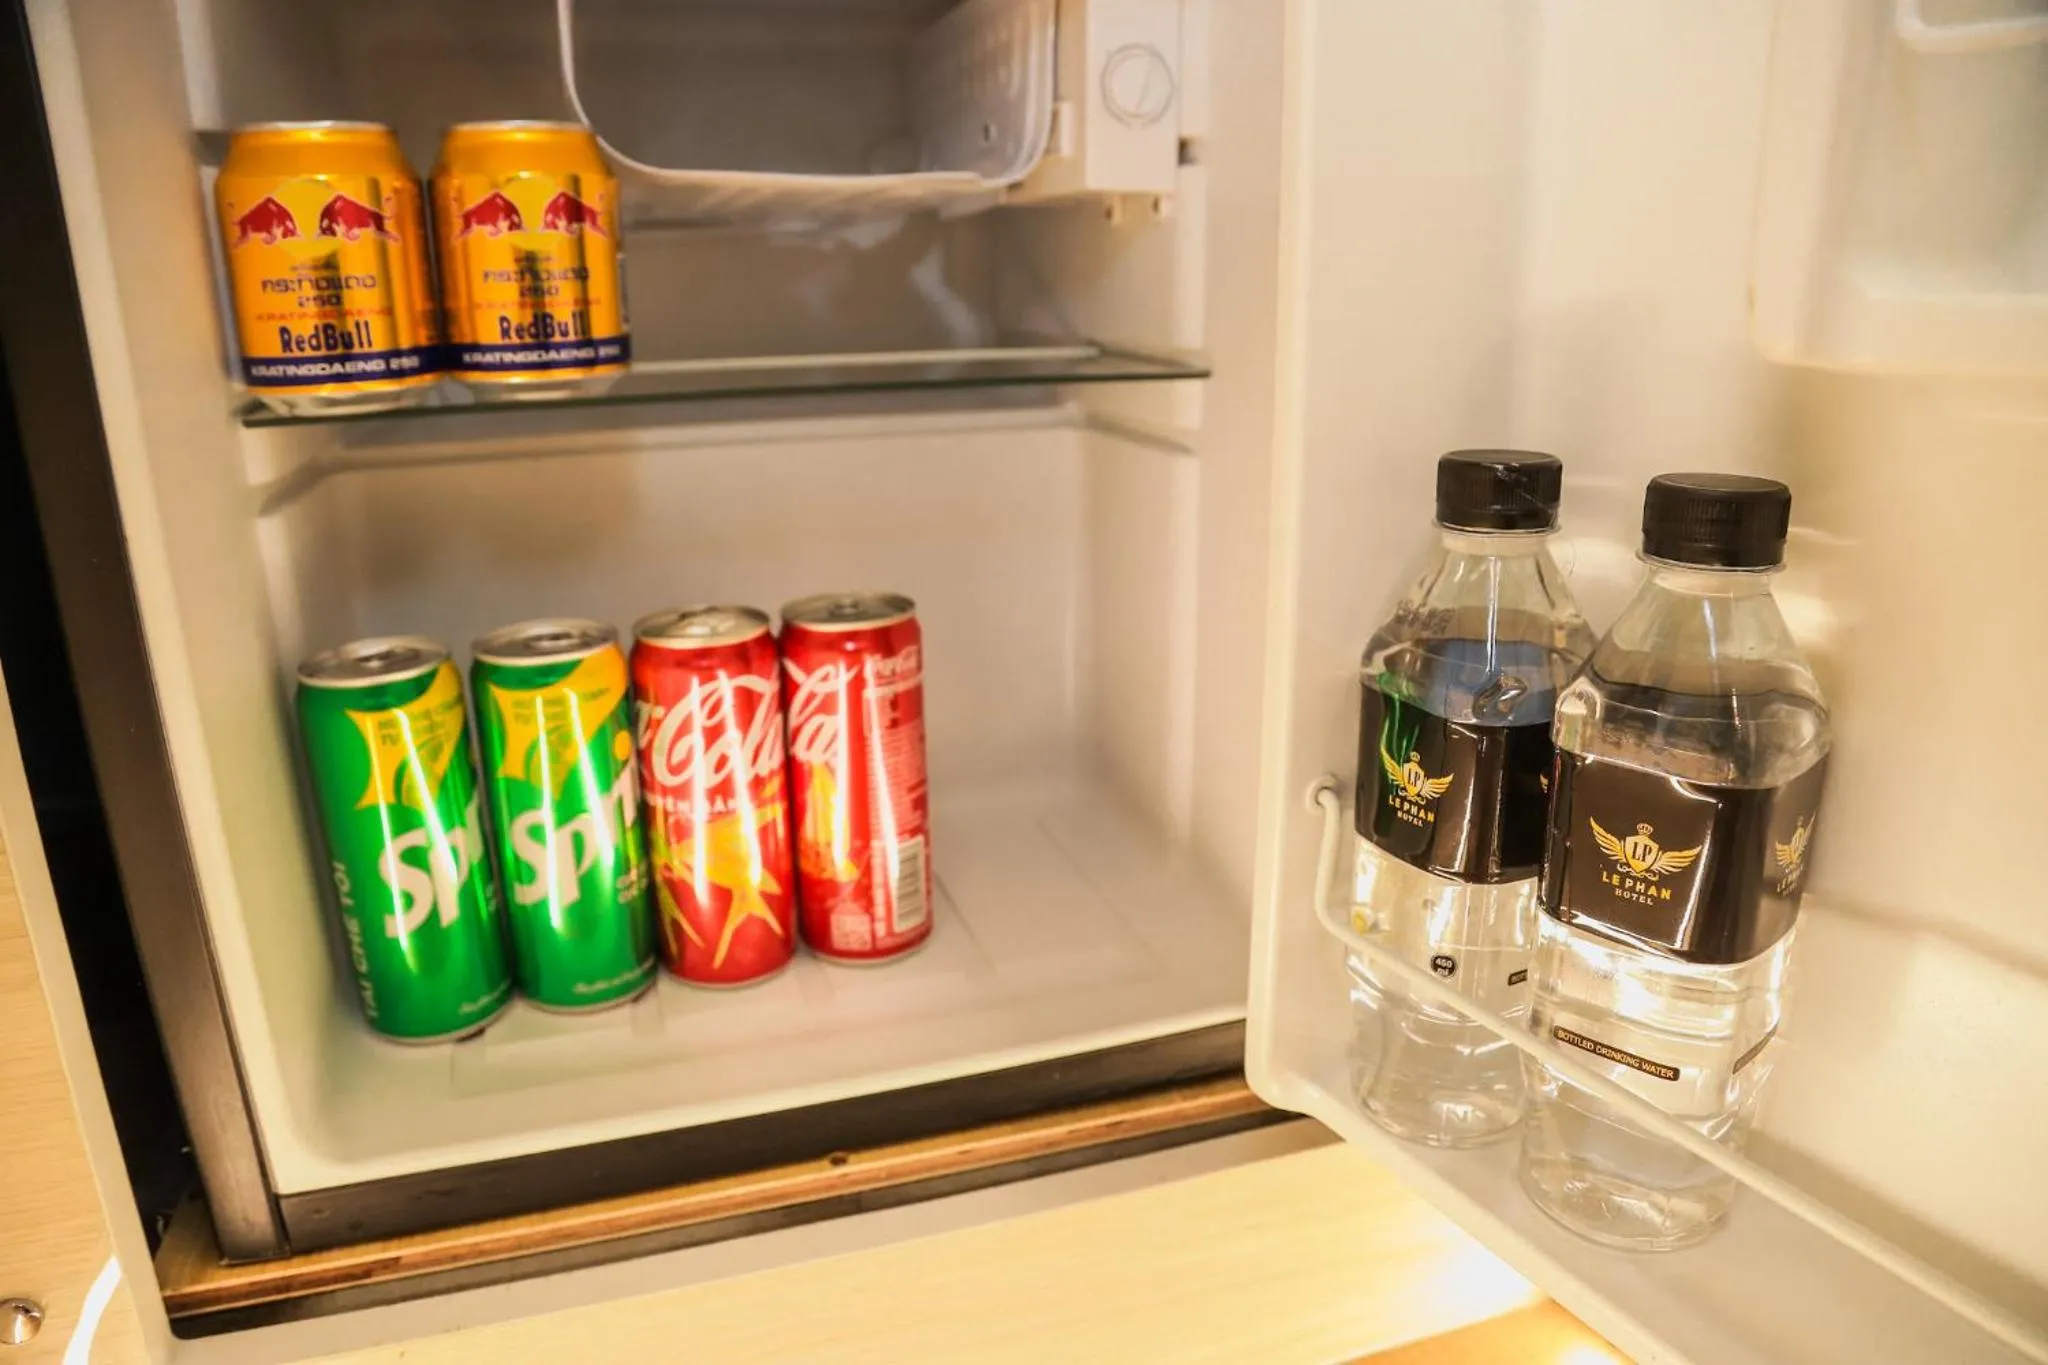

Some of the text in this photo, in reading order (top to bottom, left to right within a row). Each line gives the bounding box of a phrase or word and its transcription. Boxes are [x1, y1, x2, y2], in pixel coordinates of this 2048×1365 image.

[1403, 801, 1434, 823] PHAN
[1602, 871, 1671, 900] LE PHAN
[1615, 888, 1653, 905] HOTEL
[1557, 1030, 1674, 1079] BOTTLED DRINKING WATER
